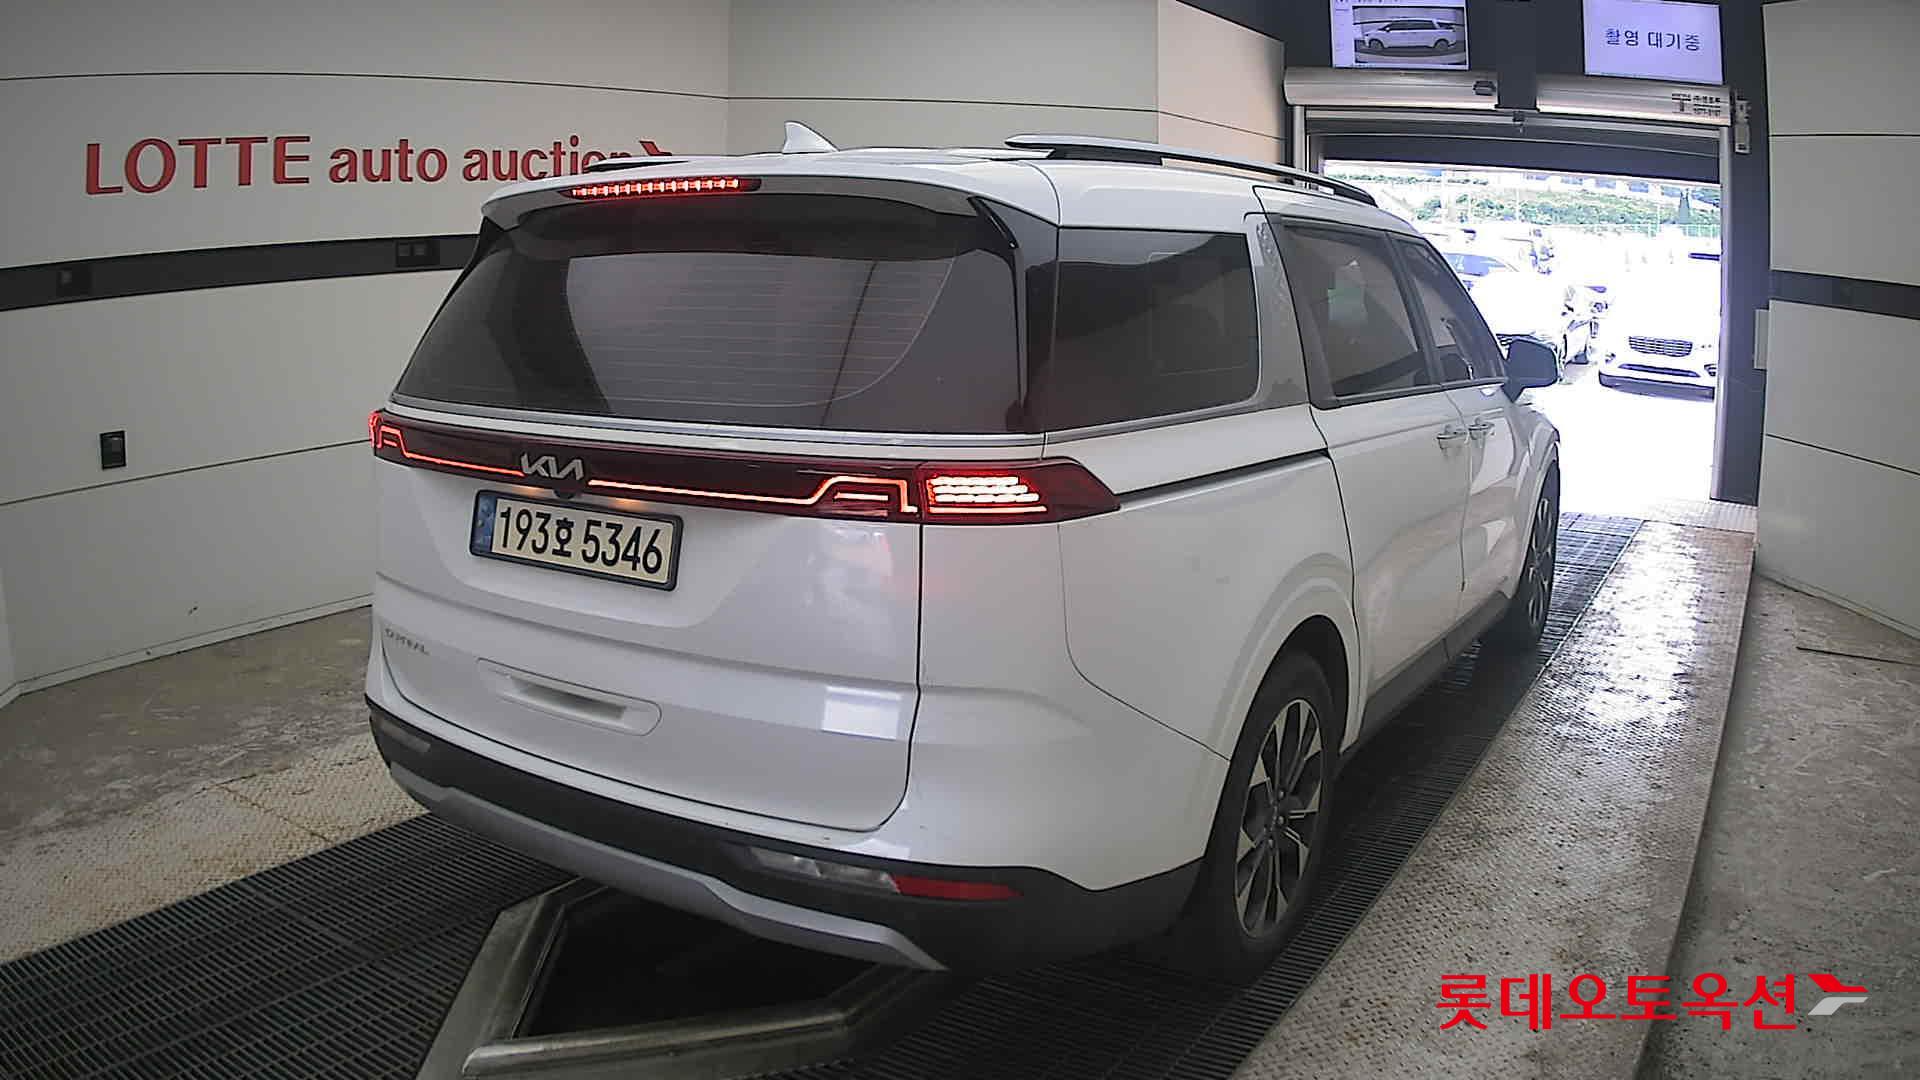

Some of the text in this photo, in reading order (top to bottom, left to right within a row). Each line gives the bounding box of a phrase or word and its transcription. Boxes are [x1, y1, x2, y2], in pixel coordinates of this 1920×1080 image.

[1647, 31, 1700, 51] 대기중
[86, 136, 310, 195] LOTTE
[328, 139, 448, 184] auto
[500, 506, 663, 574] 193호 5346
